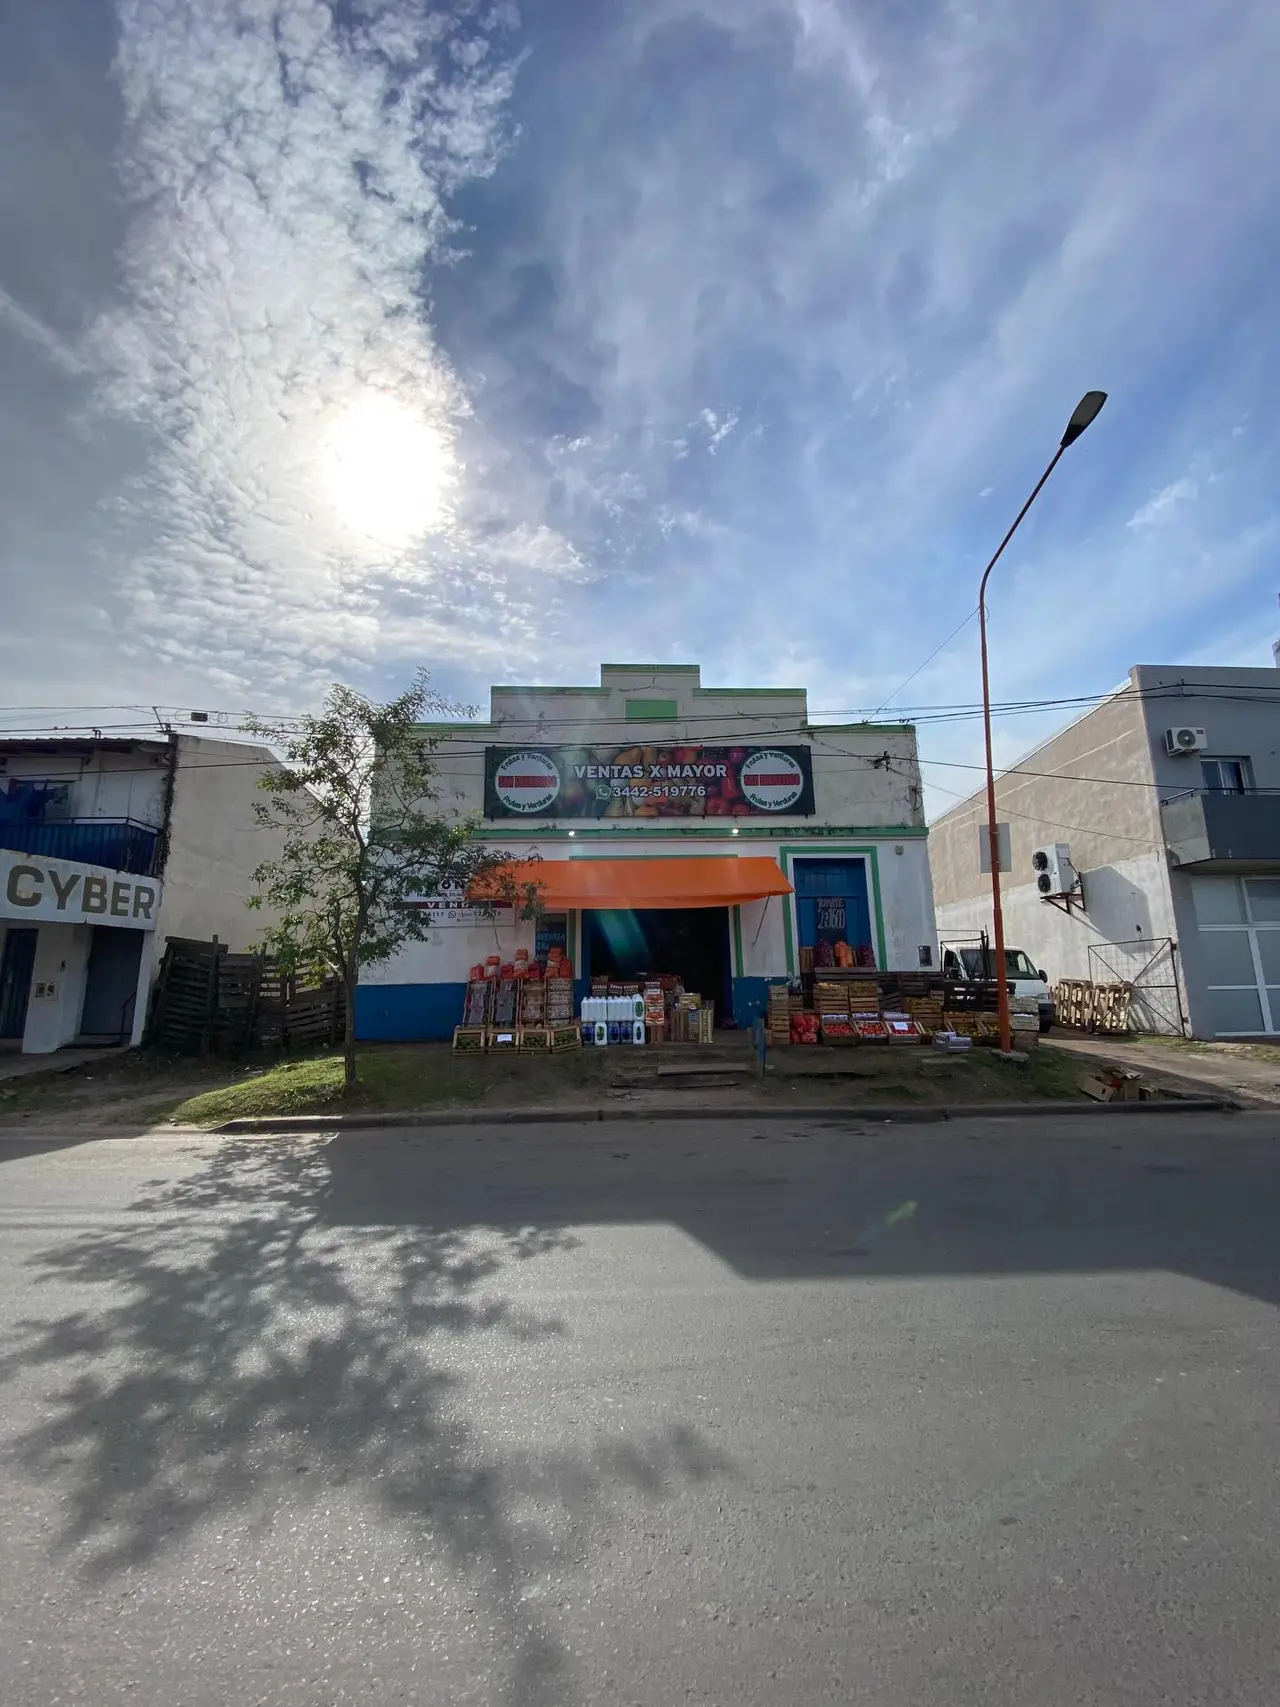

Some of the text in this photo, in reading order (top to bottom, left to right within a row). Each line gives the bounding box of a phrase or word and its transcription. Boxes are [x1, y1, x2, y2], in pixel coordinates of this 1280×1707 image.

[501, 755, 520, 770] Frutas
[745, 753, 764, 769] Frutas
[574, 764, 728, 779] VENTAS X MAYOR
[612, 786, 706, 798] 3442-519776
[503, 795, 521, 809] Frutas
[749, 793, 767, 807] Frutas
[6, 865, 156, 919] CYBER
